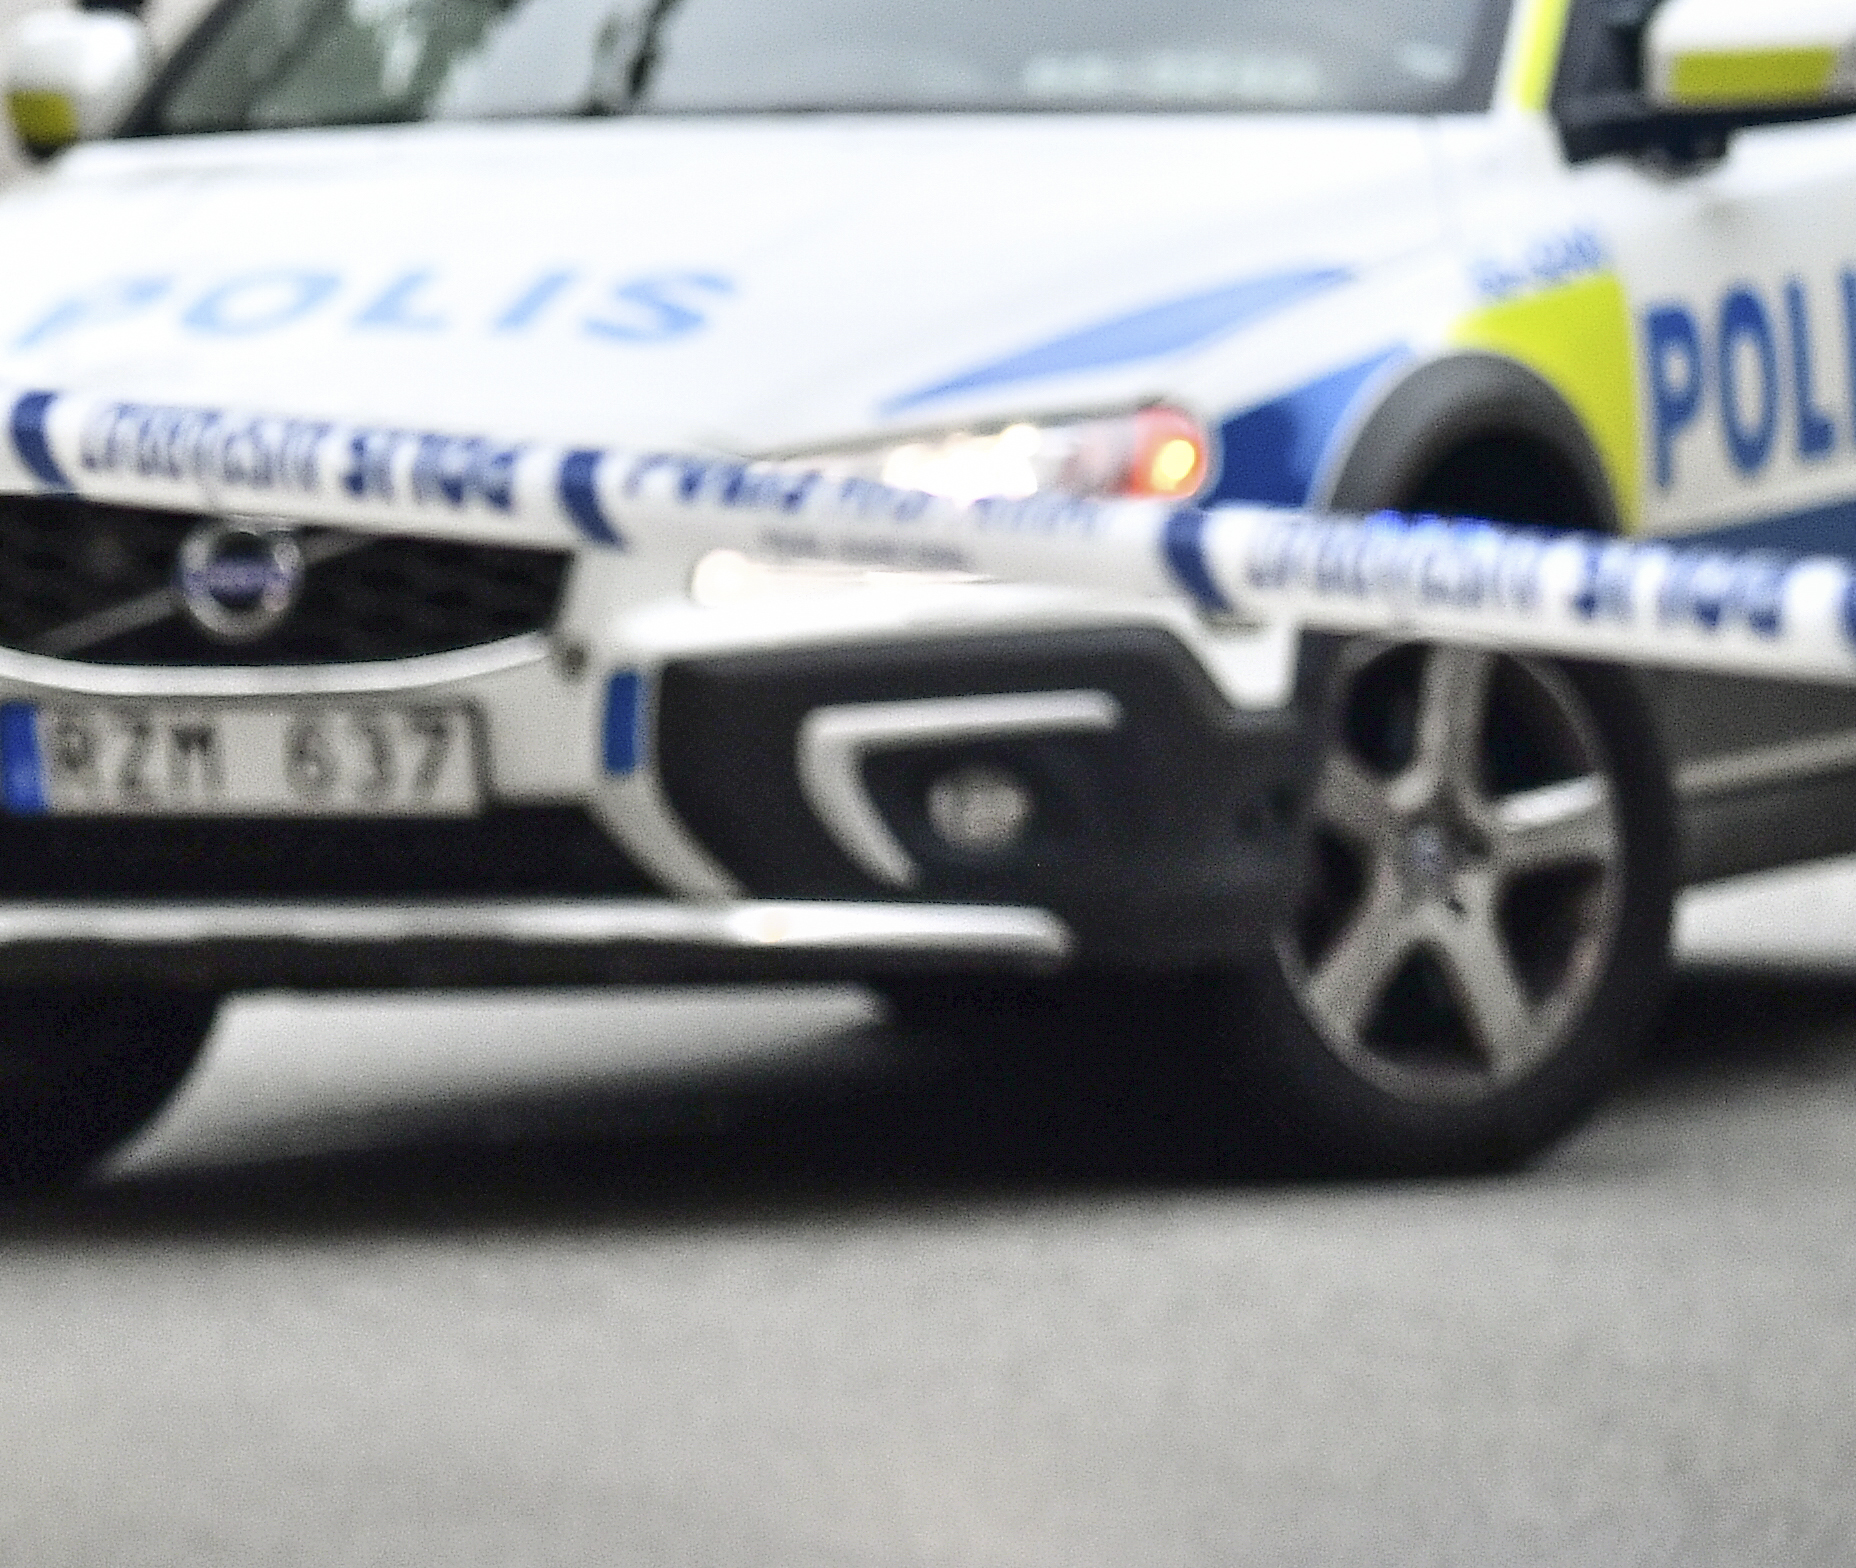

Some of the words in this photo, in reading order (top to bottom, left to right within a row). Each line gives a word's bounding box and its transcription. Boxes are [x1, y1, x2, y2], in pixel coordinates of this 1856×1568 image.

[9, 260, 743, 351] POLIS
[52, 707, 224, 798] RZM
[288, 708, 450, 798] 637
